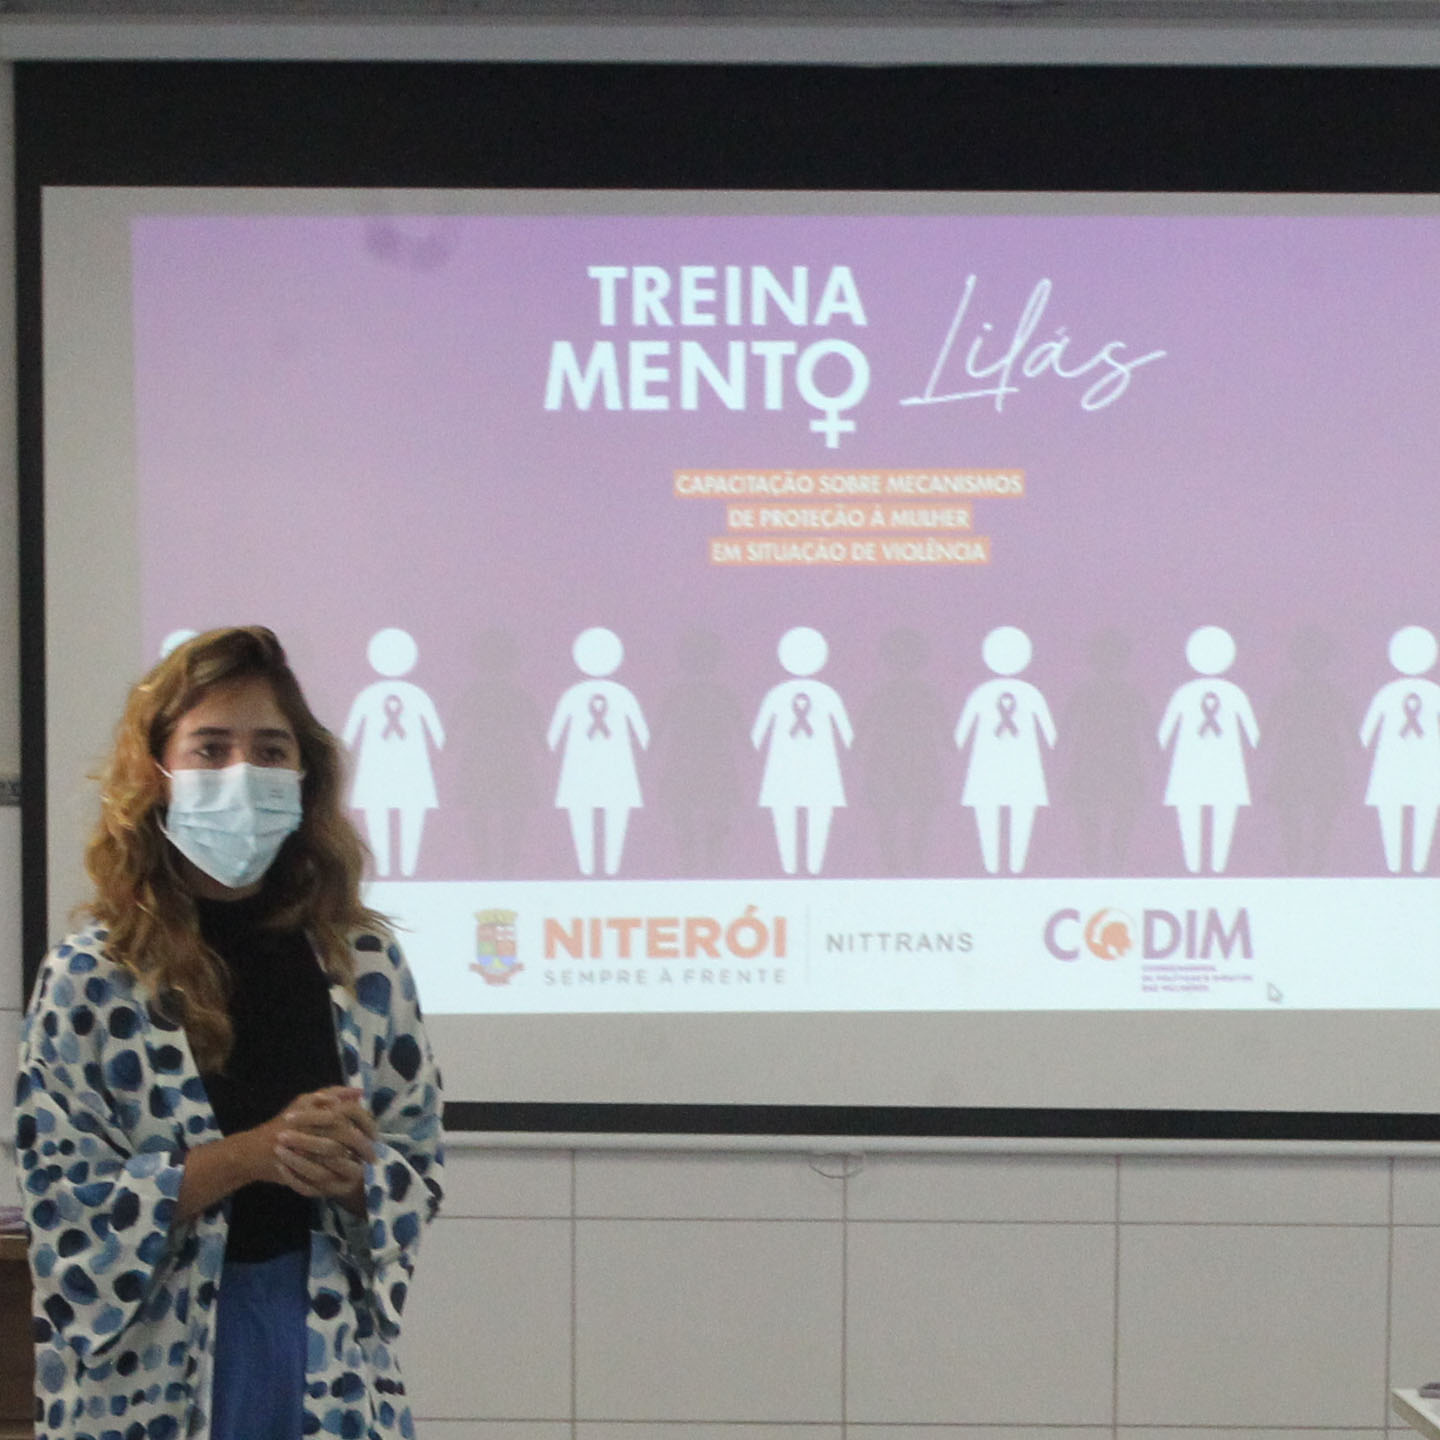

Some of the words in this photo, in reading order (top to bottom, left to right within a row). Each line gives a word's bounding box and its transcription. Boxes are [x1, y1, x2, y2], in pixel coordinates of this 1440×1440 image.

[588, 265, 868, 326] TREINA
[899, 273, 1167, 413] Lilás
[544, 338, 872, 449] MENTO
[675, 471, 813, 495] CAPACITAÇÃO
[819, 475, 881, 494] SOBRE
[886, 474, 1023, 494] MECANISMOS
[728, 508, 755, 528] DE
[760, 503, 865, 529] PROTEÇÃO
[891, 508, 970, 528] MULHER
[712, 543, 742, 562] EM
[747, 538, 847, 564] SITUAÇÃO
[851, 543, 876, 561] DE
[882, 537, 987, 561] VIOLÊNCIA
[543, 904, 787, 960] NITERÓI
[825, 932, 973, 953] NITTRANS
[544, 968, 648, 986] SEMPRE
[683, 968, 787, 985] FRENTE
